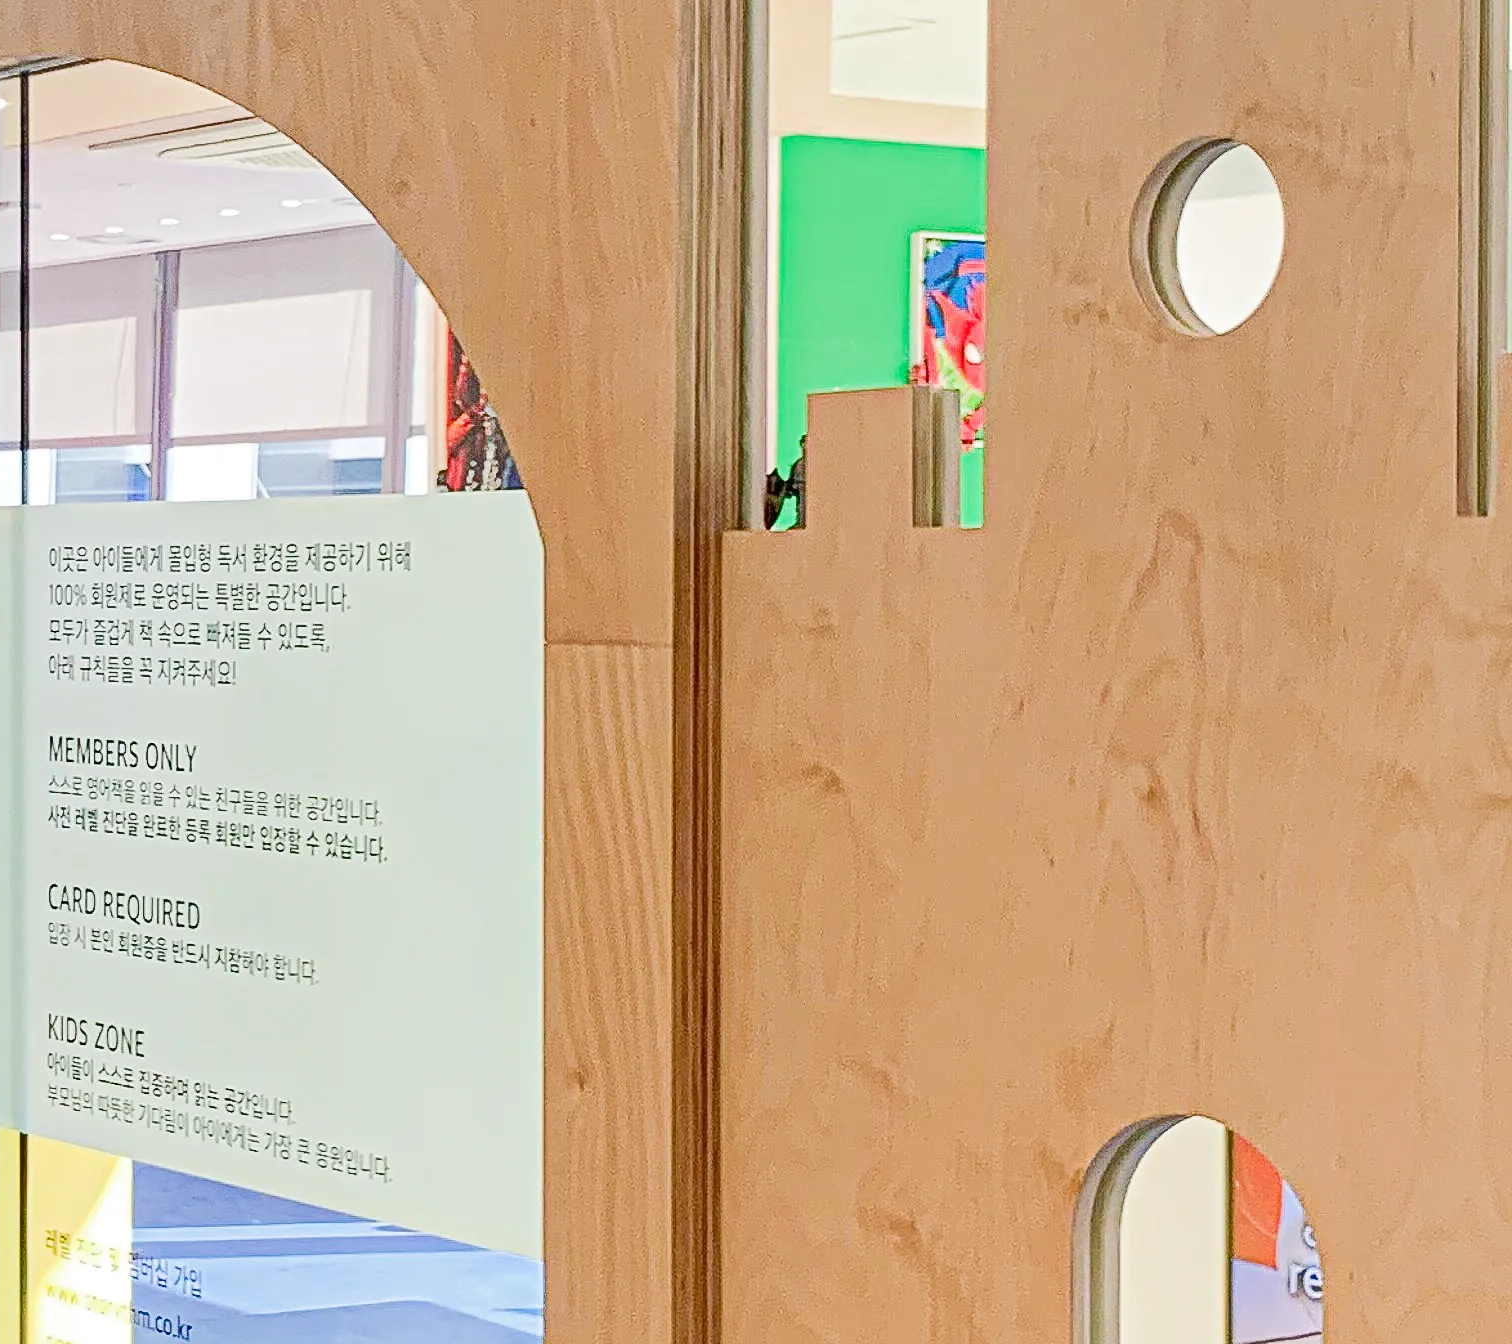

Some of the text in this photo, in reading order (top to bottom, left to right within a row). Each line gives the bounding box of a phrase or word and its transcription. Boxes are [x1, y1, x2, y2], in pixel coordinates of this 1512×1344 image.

[48, 544, 88, 571] 이곳은
[93, 544, 163, 572] 아이들에게
[218, 543, 247, 572] 독서
[253, 542, 300, 572] 환경을
[305, 542, 371, 572] 제공하기
[377, 541, 411, 572] 위해
[48, 583, 351, 612] 100% 회원제로 운영되는 특별한 공간입니다.
[49, 619, 89, 644] 모두가
[93, 619, 134, 646] 즐겁게
[140, 620, 153, 646] 책
[159, 620, 201, 646] 속으로
[258, 624, 272, 649] 수
[48, 654, 75, 681] 아래
[80, 655, 134, 684] 규칙들을
[49, 736, 197, 772] MEMBERS ONLY
[48, 776, 82, 797] 스스로
[168, 784, 182, 808] 수
[216, 788, 268, 816] 친구들을
[306, 831, 320, 856] 수
[48, 883, 200, 929] CARD REQUIRED
[48, 1013, 145, 1057] KIDS ZONE
[99, 1065, 134, 1090] 스스로
[174, 1265, 202, 1299] 가입
